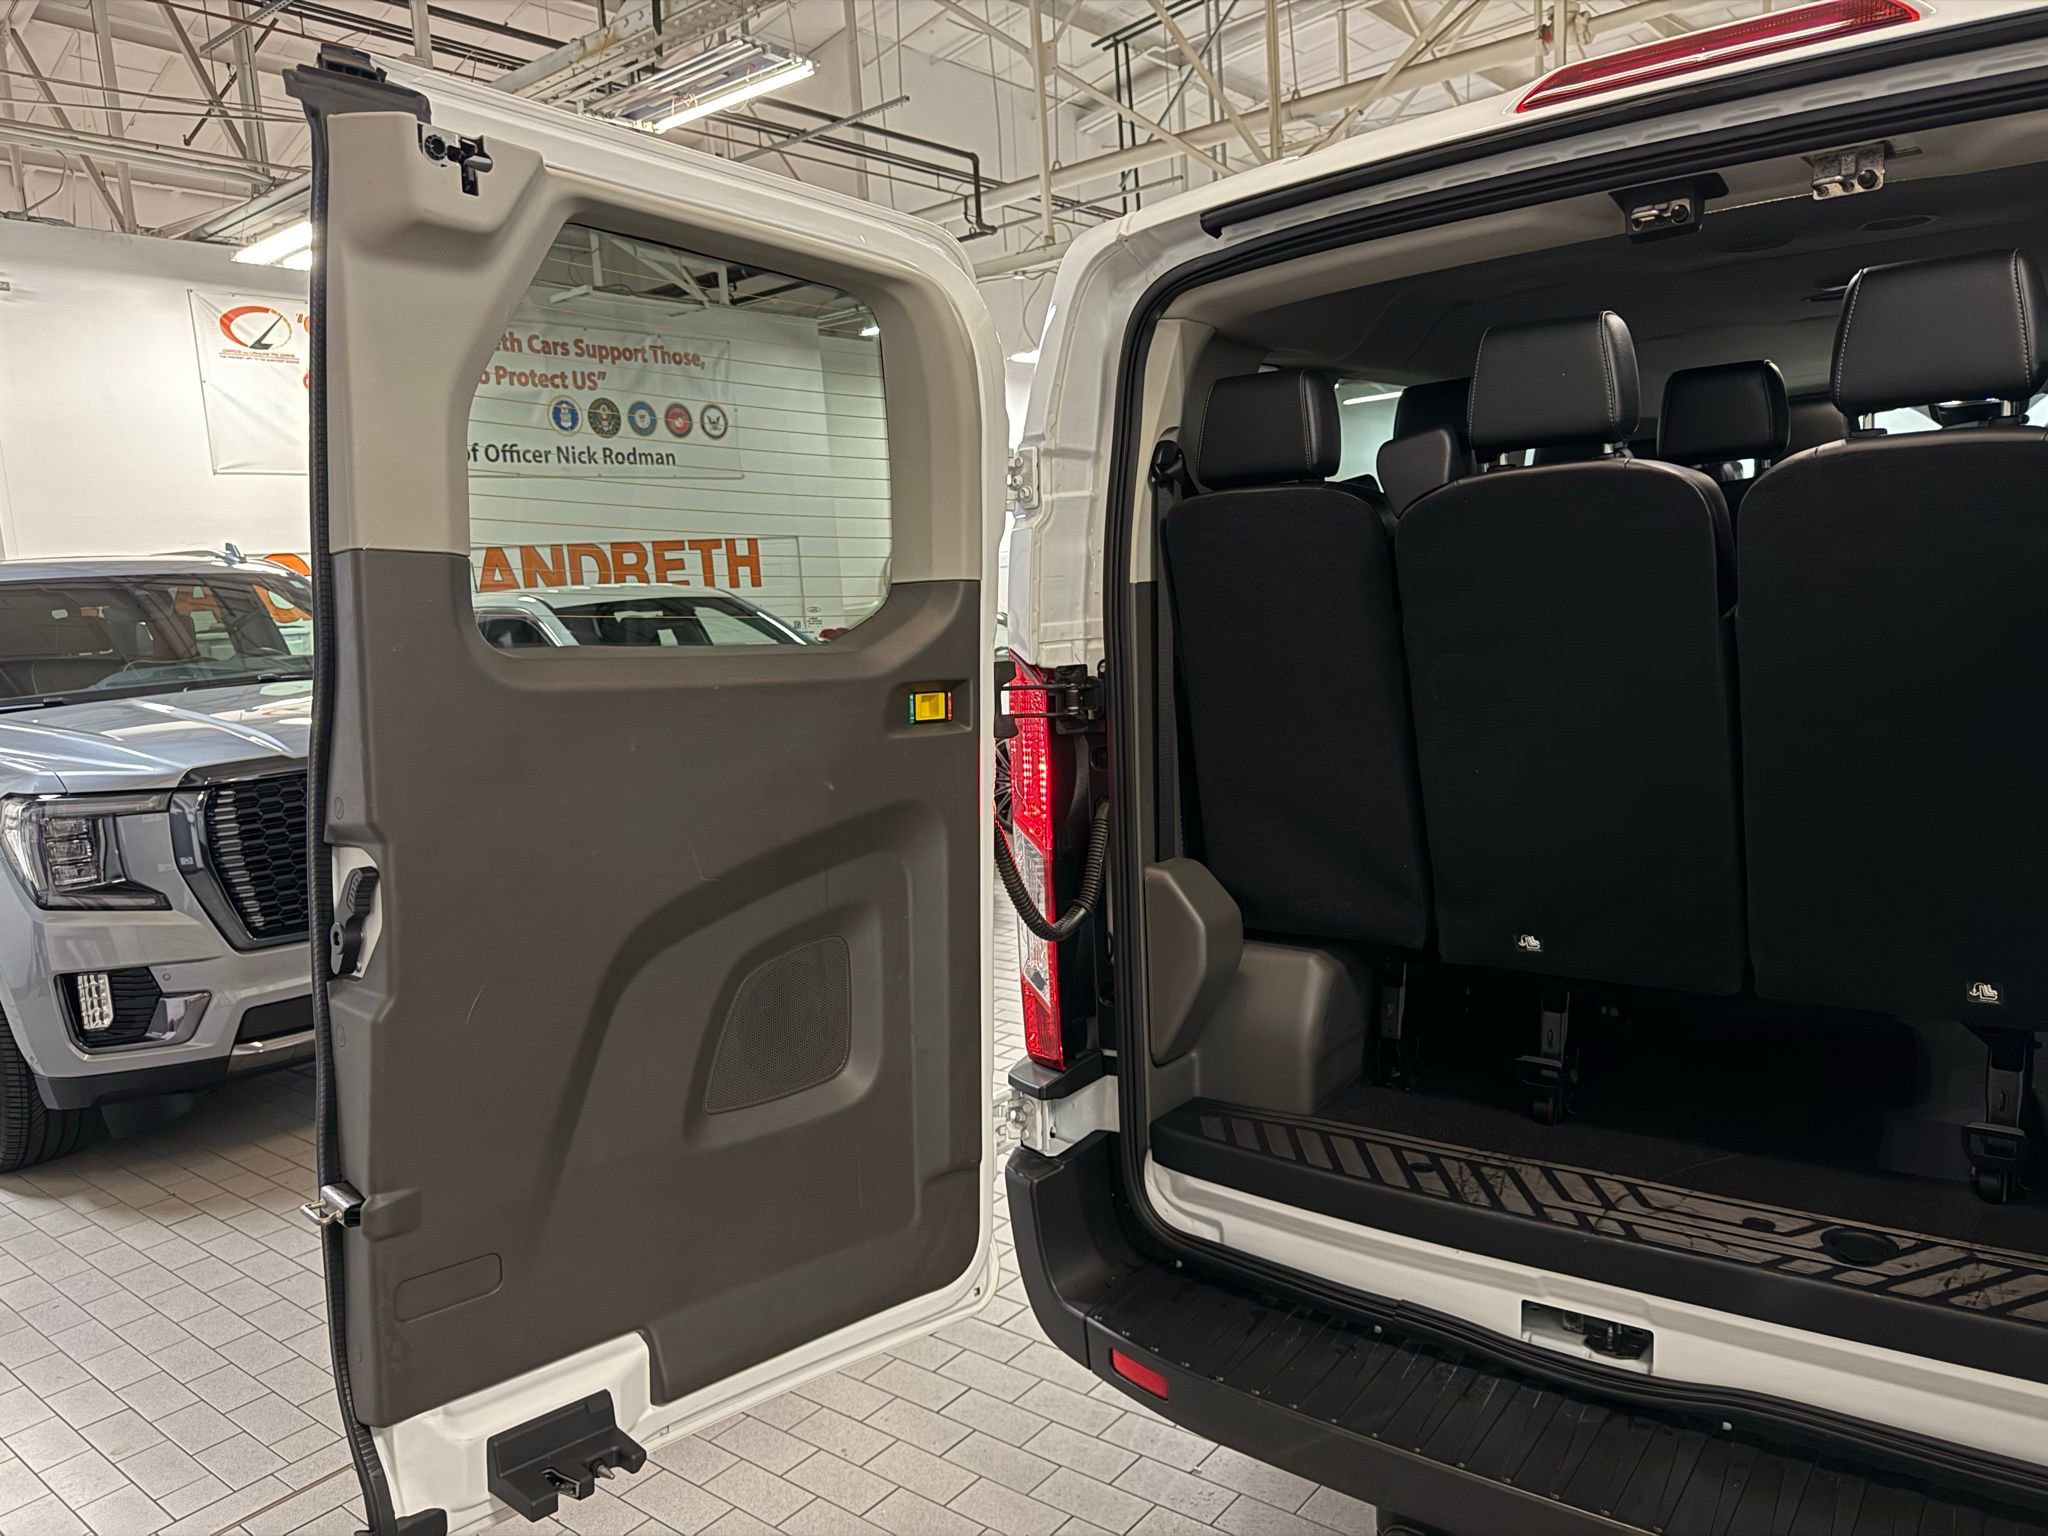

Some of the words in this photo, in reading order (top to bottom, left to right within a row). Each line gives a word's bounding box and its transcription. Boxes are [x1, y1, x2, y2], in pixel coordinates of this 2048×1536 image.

[527, 334, 570, 357] Cars
[573, 338, 648, 366] Support
[648, 345, 705, 370] Those,
[495, 365, 569, 390] Protect
[484, 443, 552, 464] Officer
[556, 445, 599, 465] Nick
[602, 446, 676, 466] Rodman
